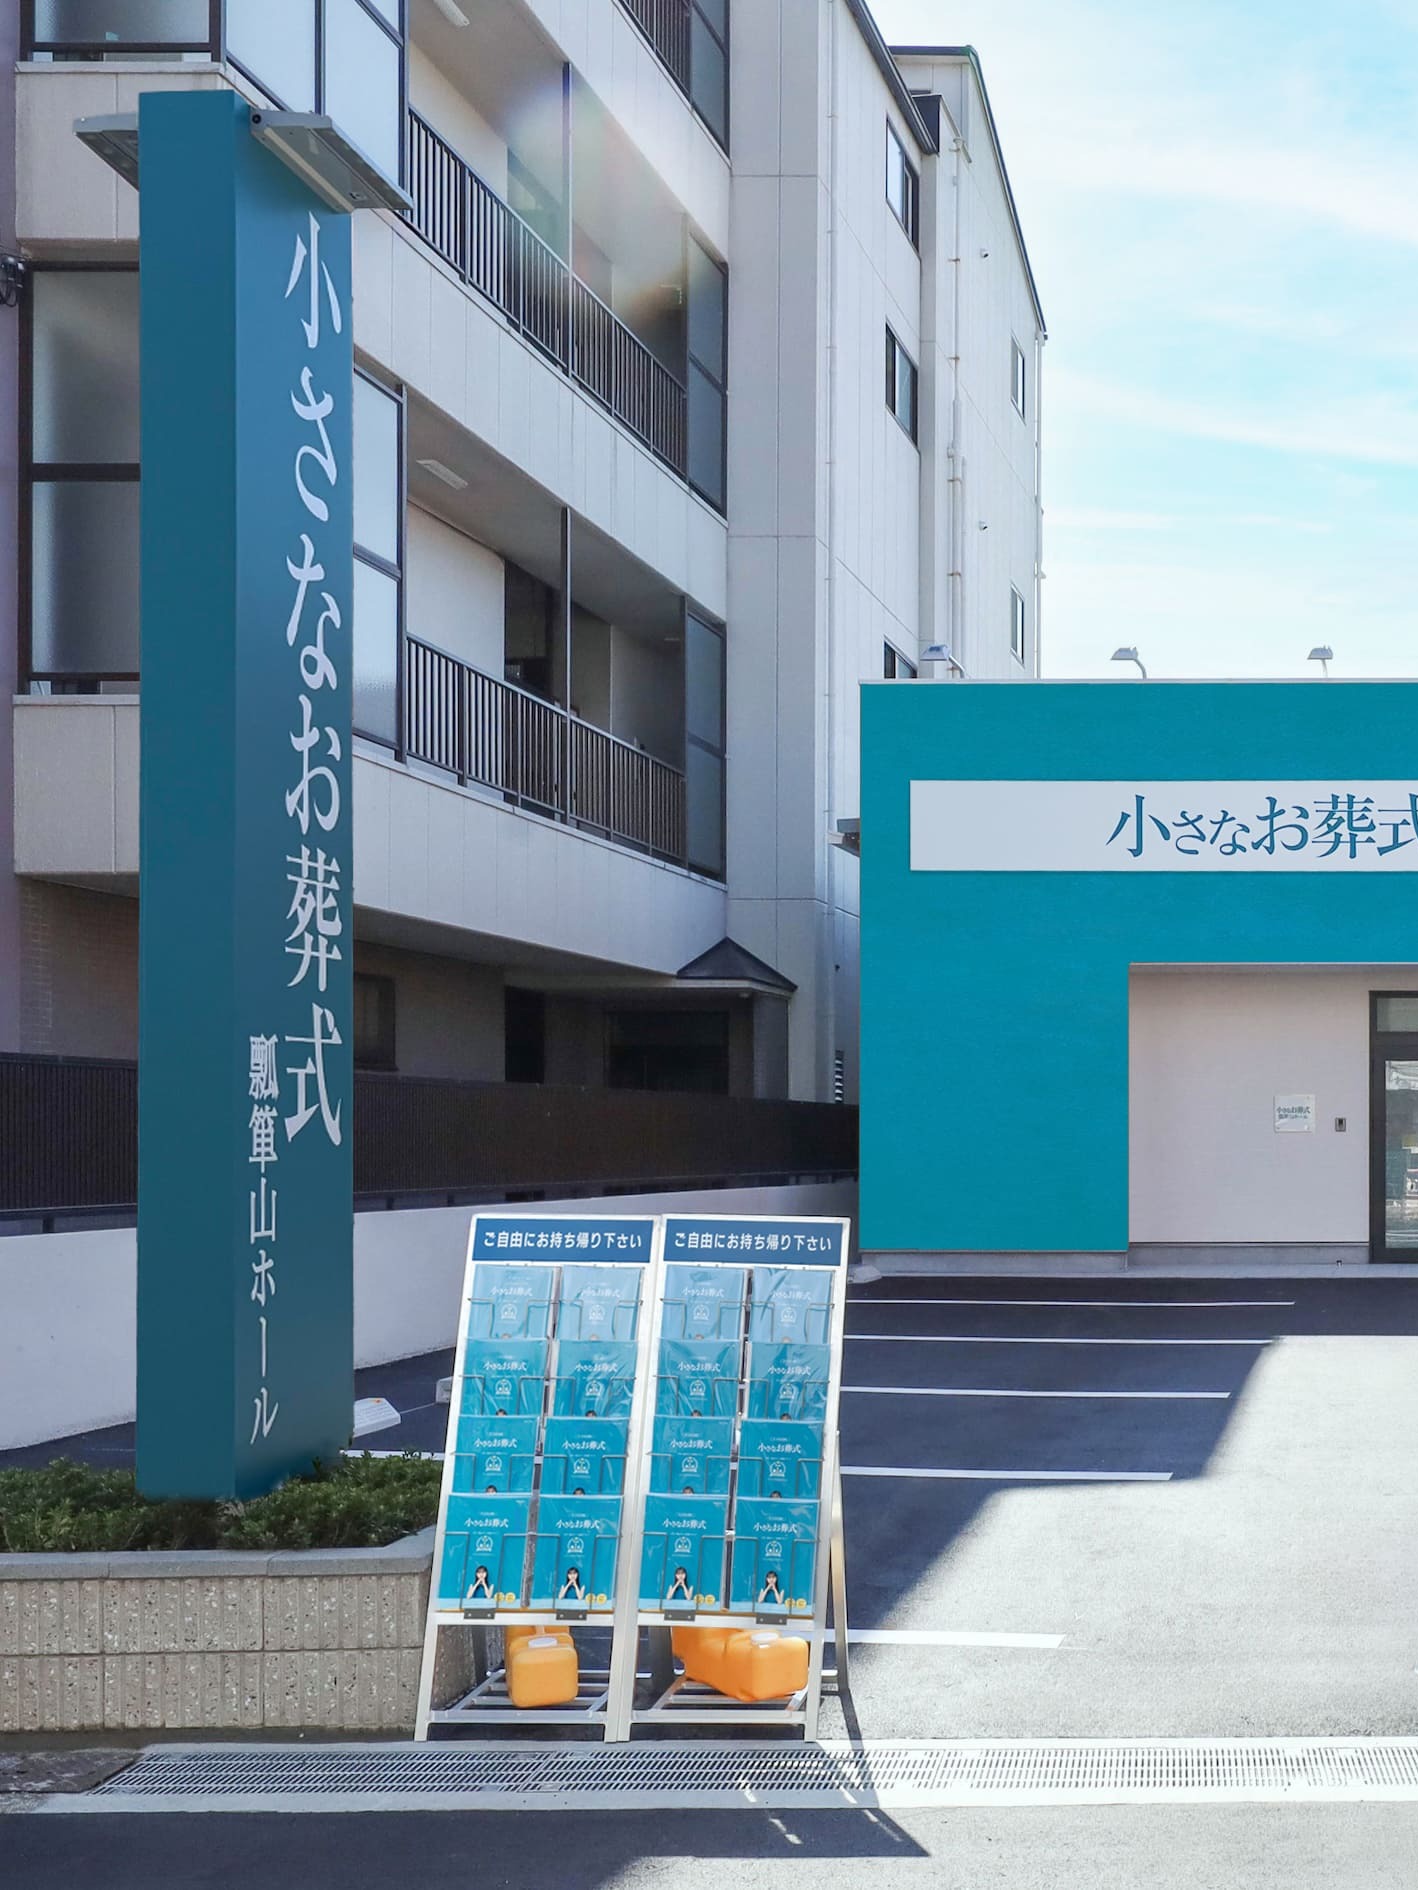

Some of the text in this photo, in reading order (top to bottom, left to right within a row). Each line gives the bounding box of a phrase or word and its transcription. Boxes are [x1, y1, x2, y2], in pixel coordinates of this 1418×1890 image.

[284, 211, 343, 1146] 小さなお葬式
[483, 1230, 643, 1249] ご自由にお持ち帰り下さい
[674, 1231, 832, 1251] ご自由にお持ち帰り下さい
